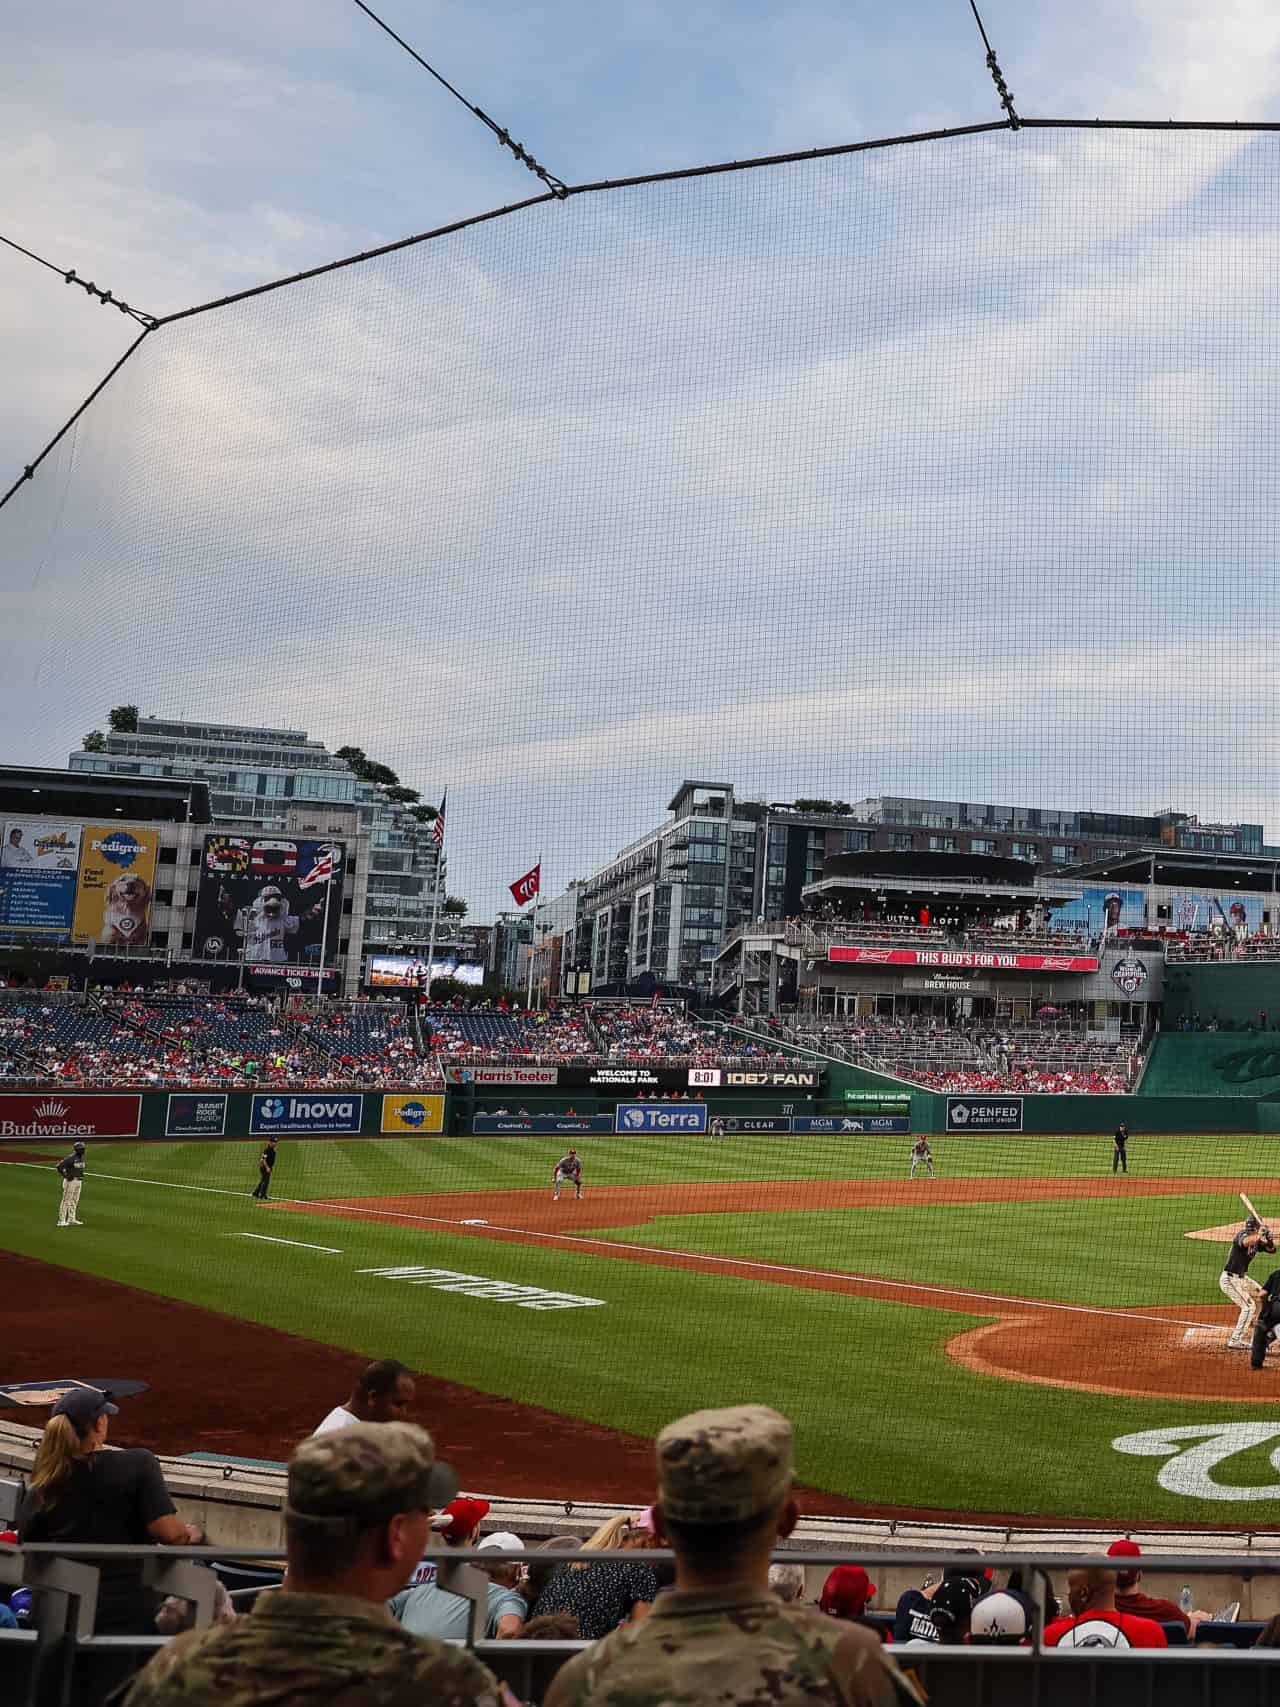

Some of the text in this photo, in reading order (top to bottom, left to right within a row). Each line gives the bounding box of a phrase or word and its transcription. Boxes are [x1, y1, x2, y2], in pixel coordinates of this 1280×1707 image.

[91, 839, 148, 855] Pedigree
[915, 951, 1019, 967] THIS BUD'S FOR YOU.
[254, 965, 285, 977] ADVANCE
[286, 968, 309, 978] TICKET
[924, 980, 971, 990] BREW HOUSE
[473, 1070, 554, 1083] Harris Teeter
[597, 1069, 651, 1077] WELCOME TO
[693, 1071, 715, 1084] 8:01
[772, 1073, 815, 1086] FAN
[589, 1076, 659, 1084] NATIONALS PARK
[289, 1098, 354, 1119] Inova
[971, 1106, 1018, 1118] PENFED
[649, 1110, 699, 1127] Terra
[744, 1120, 774, 1129] CLEAR
[811, 1119, 833, 1129] MGM
[870, 1118, 894, 1129] MGM
[1, 1120, 97, 1136] Budweiser
